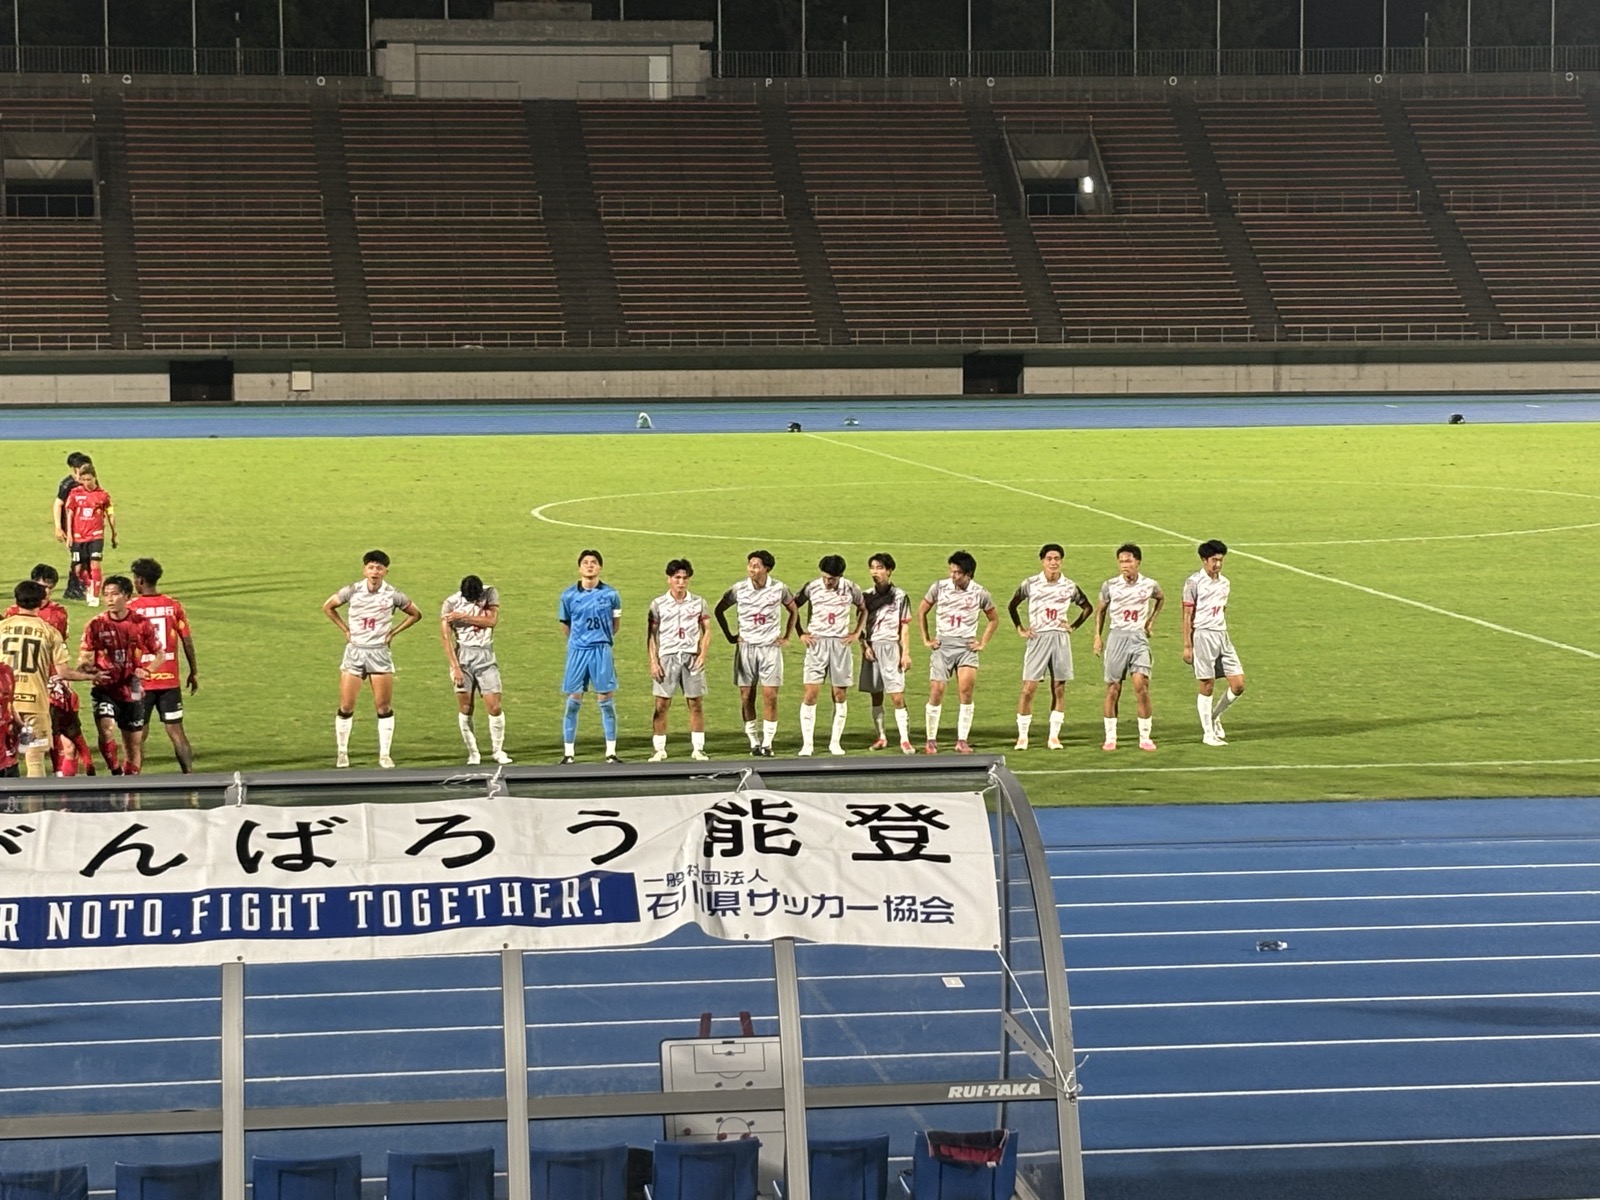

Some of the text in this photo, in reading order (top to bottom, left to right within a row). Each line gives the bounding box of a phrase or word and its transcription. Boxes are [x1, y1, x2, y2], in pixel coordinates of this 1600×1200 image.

[765, 77, 773, 88] P
[949, 614, 962, 628] 11
[1045, 607, 1058, 621] 10
[1123, 609, 1139, 623] 24
[361, 617, 376, 631] 14
[586, 616, 601, 631] 28
[2, 637, 41, 674] 50
[99, 702, 115, 716] 55
[350, 877, 603, 929] TOGETHER!
[645, 880, 955, 924] 石川県サッカー協会
[947, 1082, 1042, 1099] RUI-TAKA
